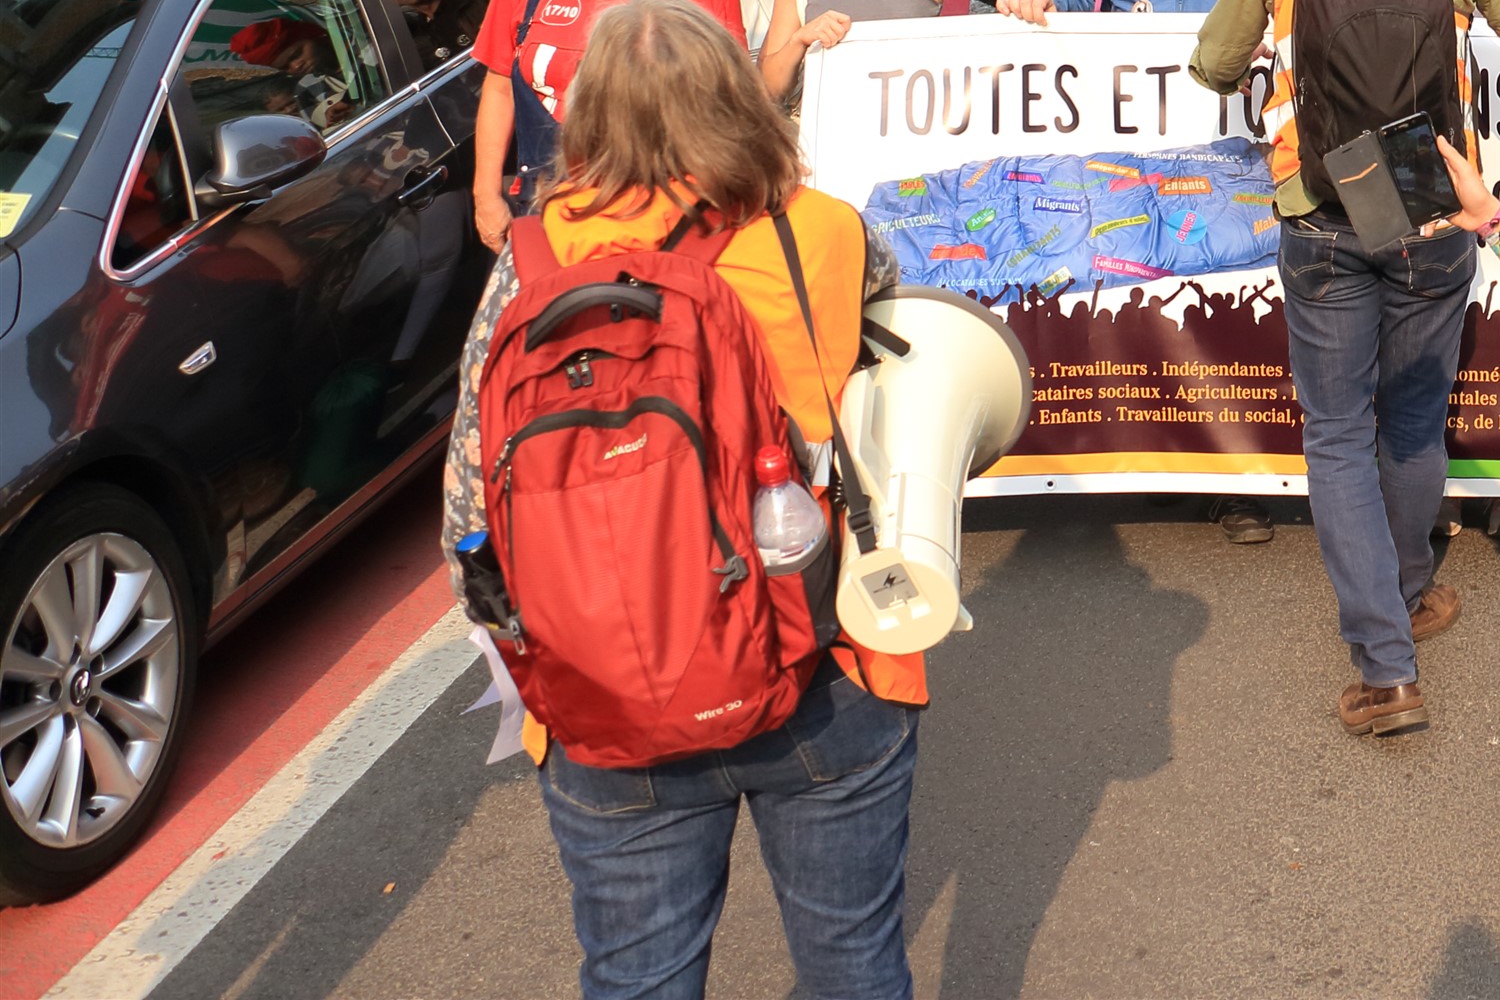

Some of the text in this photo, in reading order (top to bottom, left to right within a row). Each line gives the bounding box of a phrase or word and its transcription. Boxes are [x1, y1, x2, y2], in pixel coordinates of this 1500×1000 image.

[545, 4, 579, 18] 17/10
[869, 63, 1079, 137] TOUTES
[1113, 64, 1181, 136] ET
[1164, 178, 1207, 192] Enfants
[1035, 196, 1081, 213] Migrants
[870, 212, 941, 235] GRICULTEURS
[1175, 211, 1197, 243] JEUNES
[1050, 361, 1148, 378] Travailleurs
[1161, 360, 1284, 380] Indépendantes
[1031, 385, 1093, 401] cataires
[1099, 384, 1161, 399] sociaux
[1175, 385, 1278, 404] Agriculteurs
[1447, 390, 1498, 407] ntales
[1039, 408, 1102, 425] Enfants
[1116, 406, 1214, 424] Travailleurs
[1218, 407, 1240, 423] du
[1244, 407, 1297, 428] social,
[1473, 413, 1494, 430] de
[694, 699, 743, 722] Wire 30
